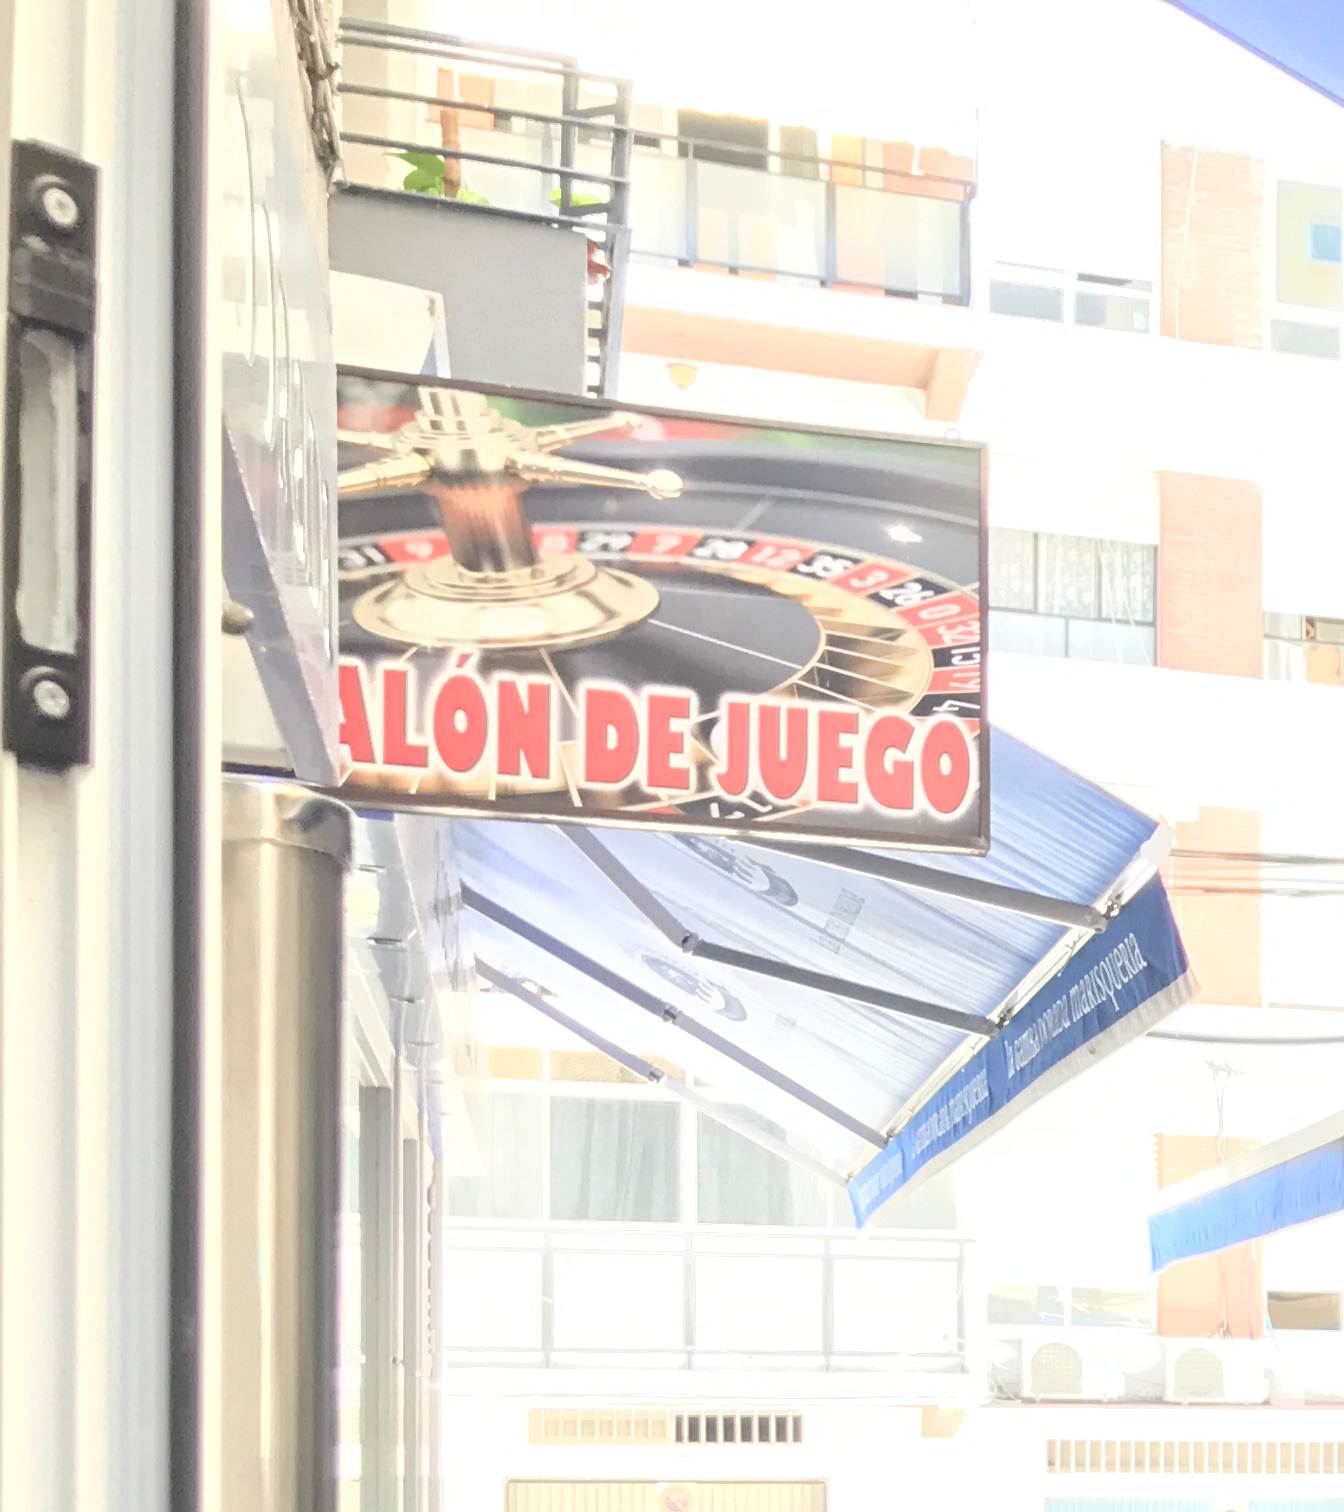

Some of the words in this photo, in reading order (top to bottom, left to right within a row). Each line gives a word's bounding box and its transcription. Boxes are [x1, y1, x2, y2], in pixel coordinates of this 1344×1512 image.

[750, 545, 802, 566] 12
[797, 555, 853, 579] 35
[584, 689, 692, 791] DE
[716, 702, 971, 815] JUEGO
